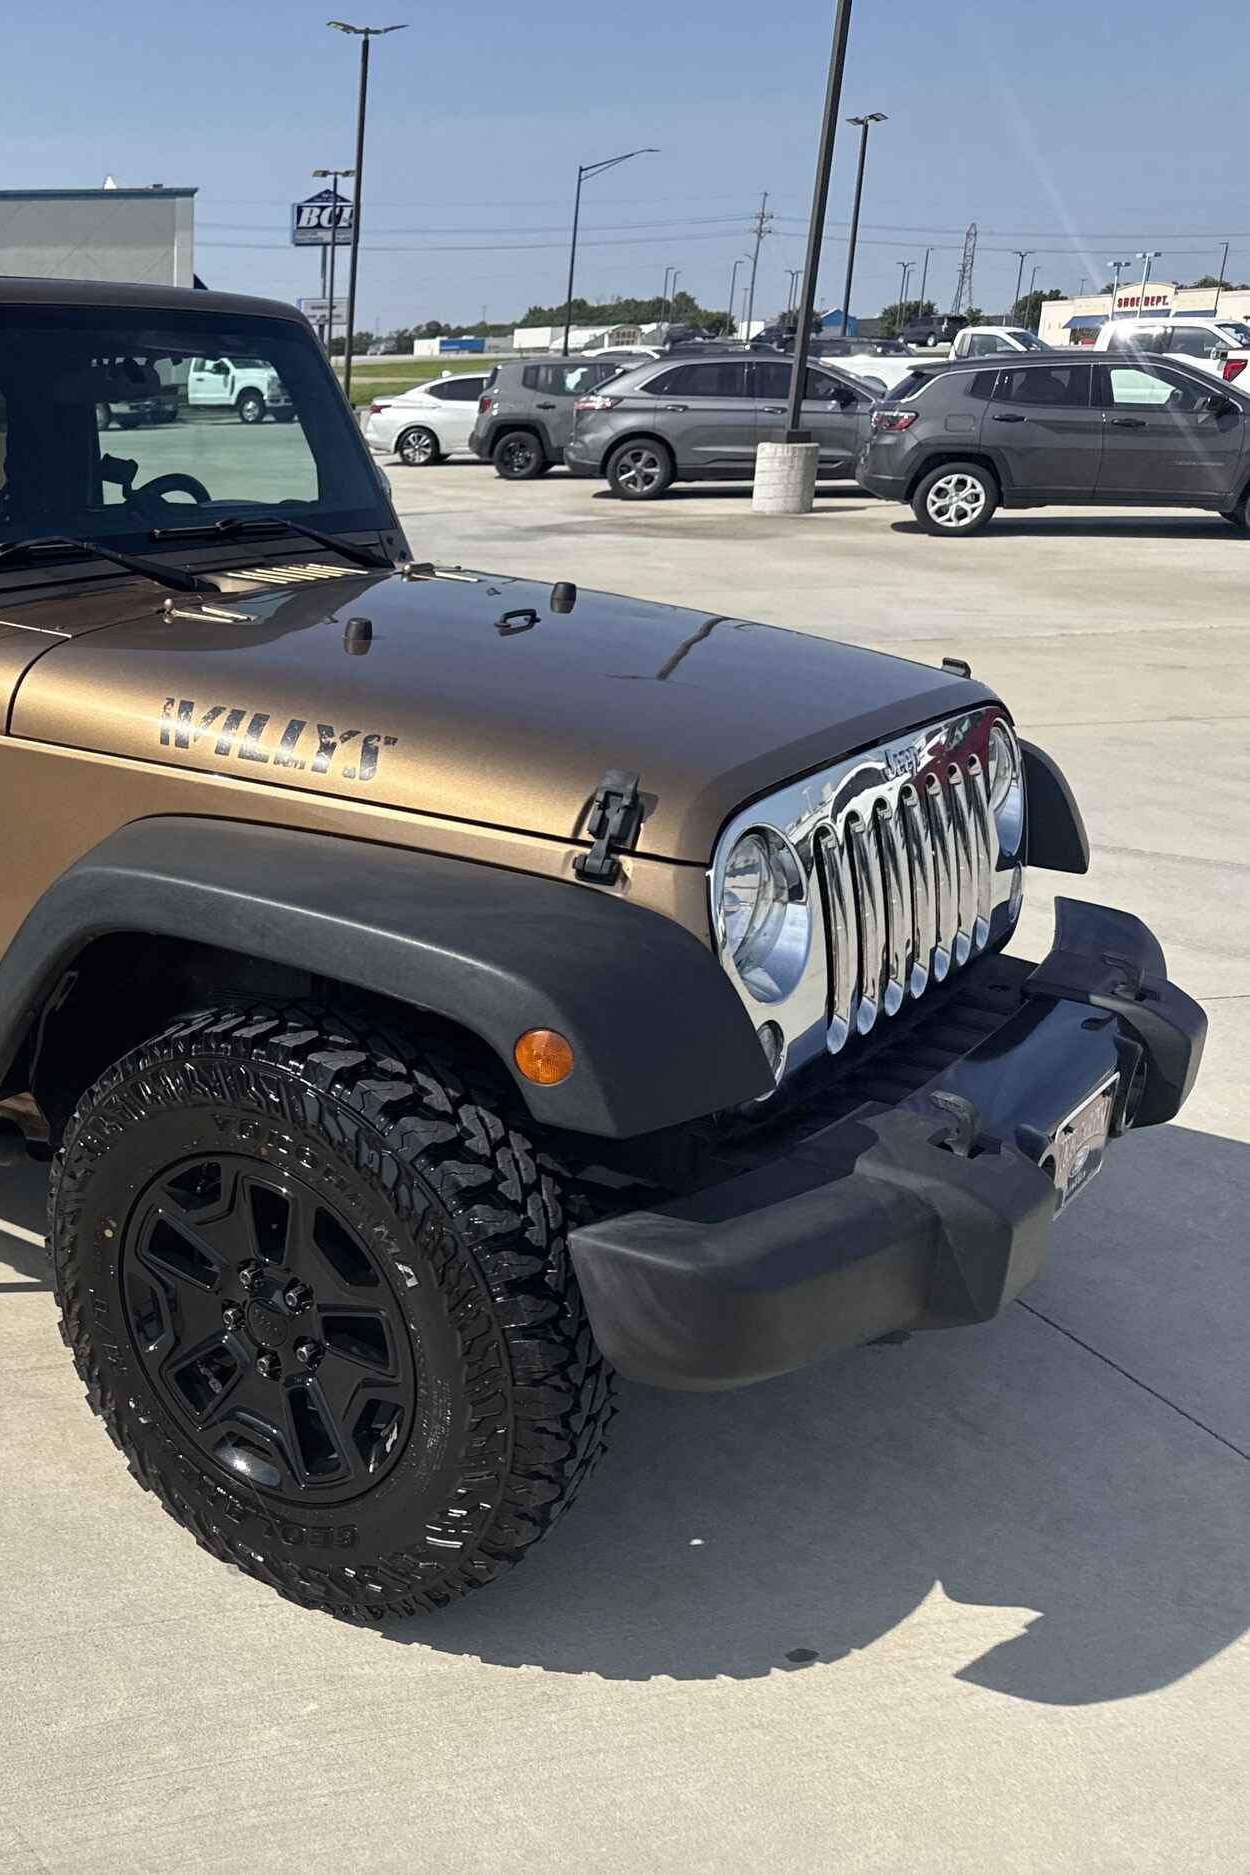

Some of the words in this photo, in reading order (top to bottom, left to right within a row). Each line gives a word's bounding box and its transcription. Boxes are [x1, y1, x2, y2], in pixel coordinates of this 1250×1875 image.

[1116, 296, 1141, 308] SHOE
[159, 697, 399, 782] WILLYS
[881, 745, 921, 782] Jeep
[210, 1112, 419, 1289] YOKOHAMA
